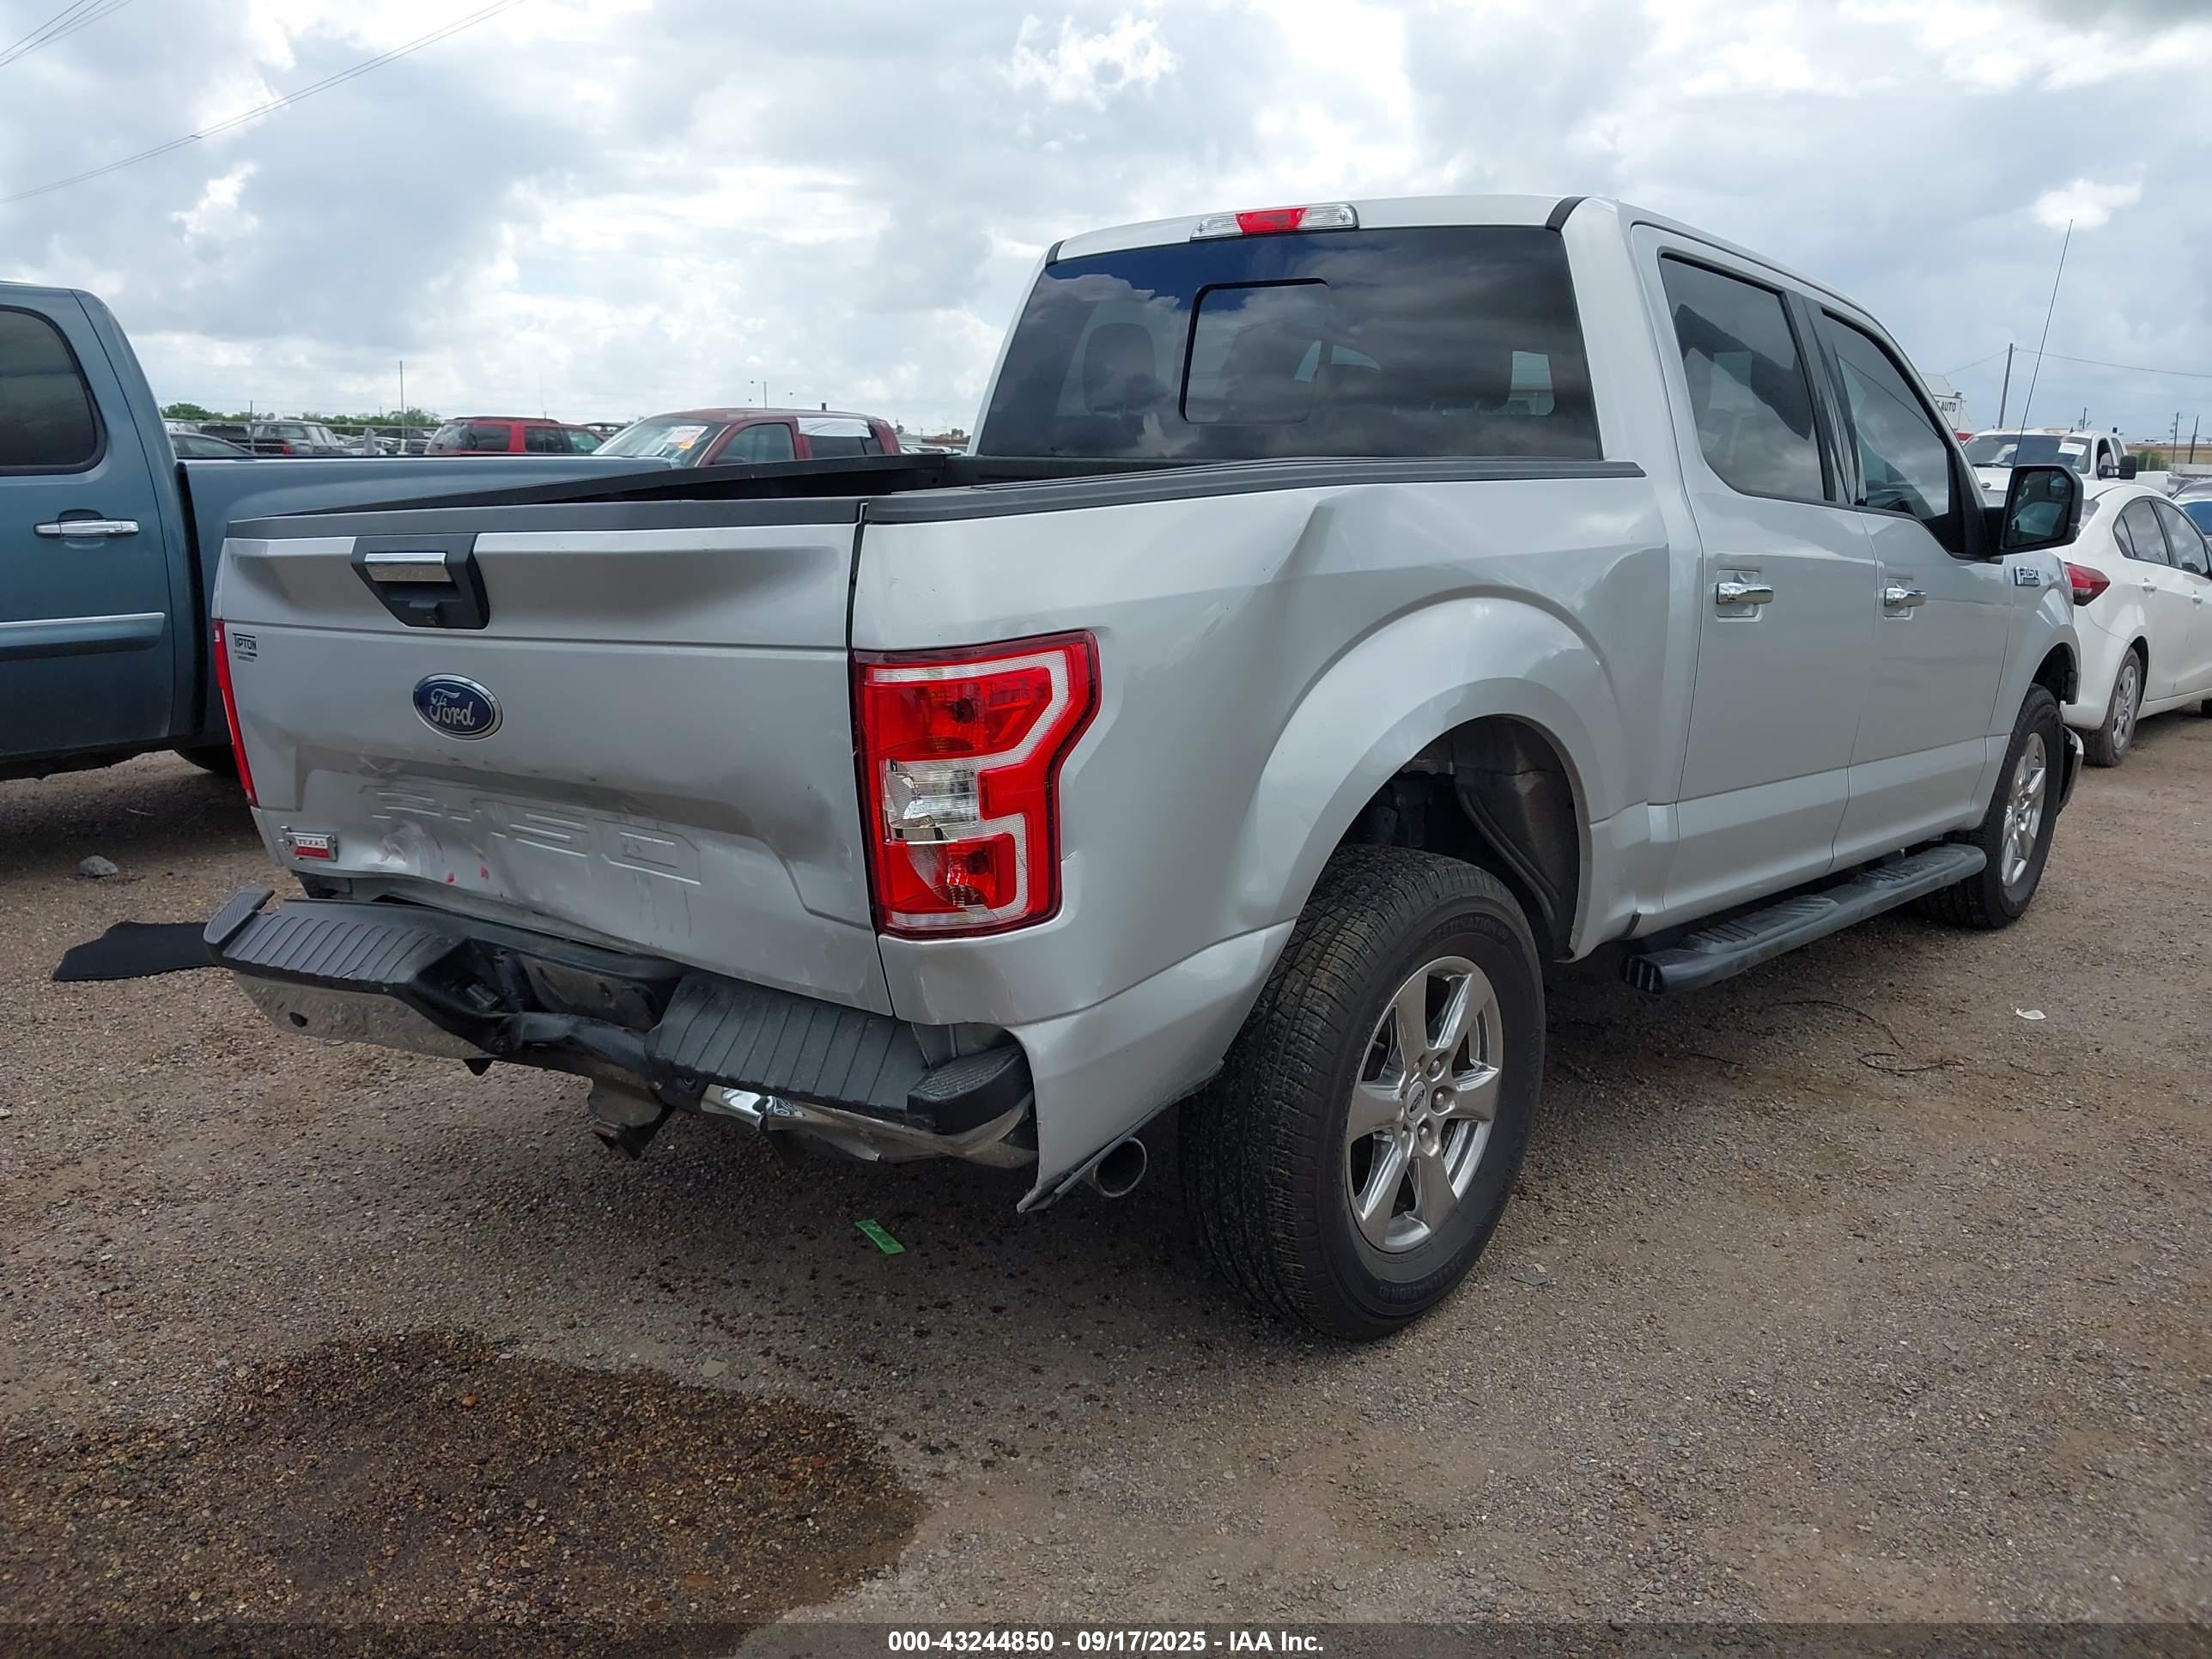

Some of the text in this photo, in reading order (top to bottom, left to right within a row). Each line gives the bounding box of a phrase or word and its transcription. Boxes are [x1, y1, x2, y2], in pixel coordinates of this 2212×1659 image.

[1941, 401, 1957, 412] AUTO
[232, 632, 257, 651] TIPTON
[428, 688, 476, 727] Ford
[297, 838, 326, 847] TEXAS
